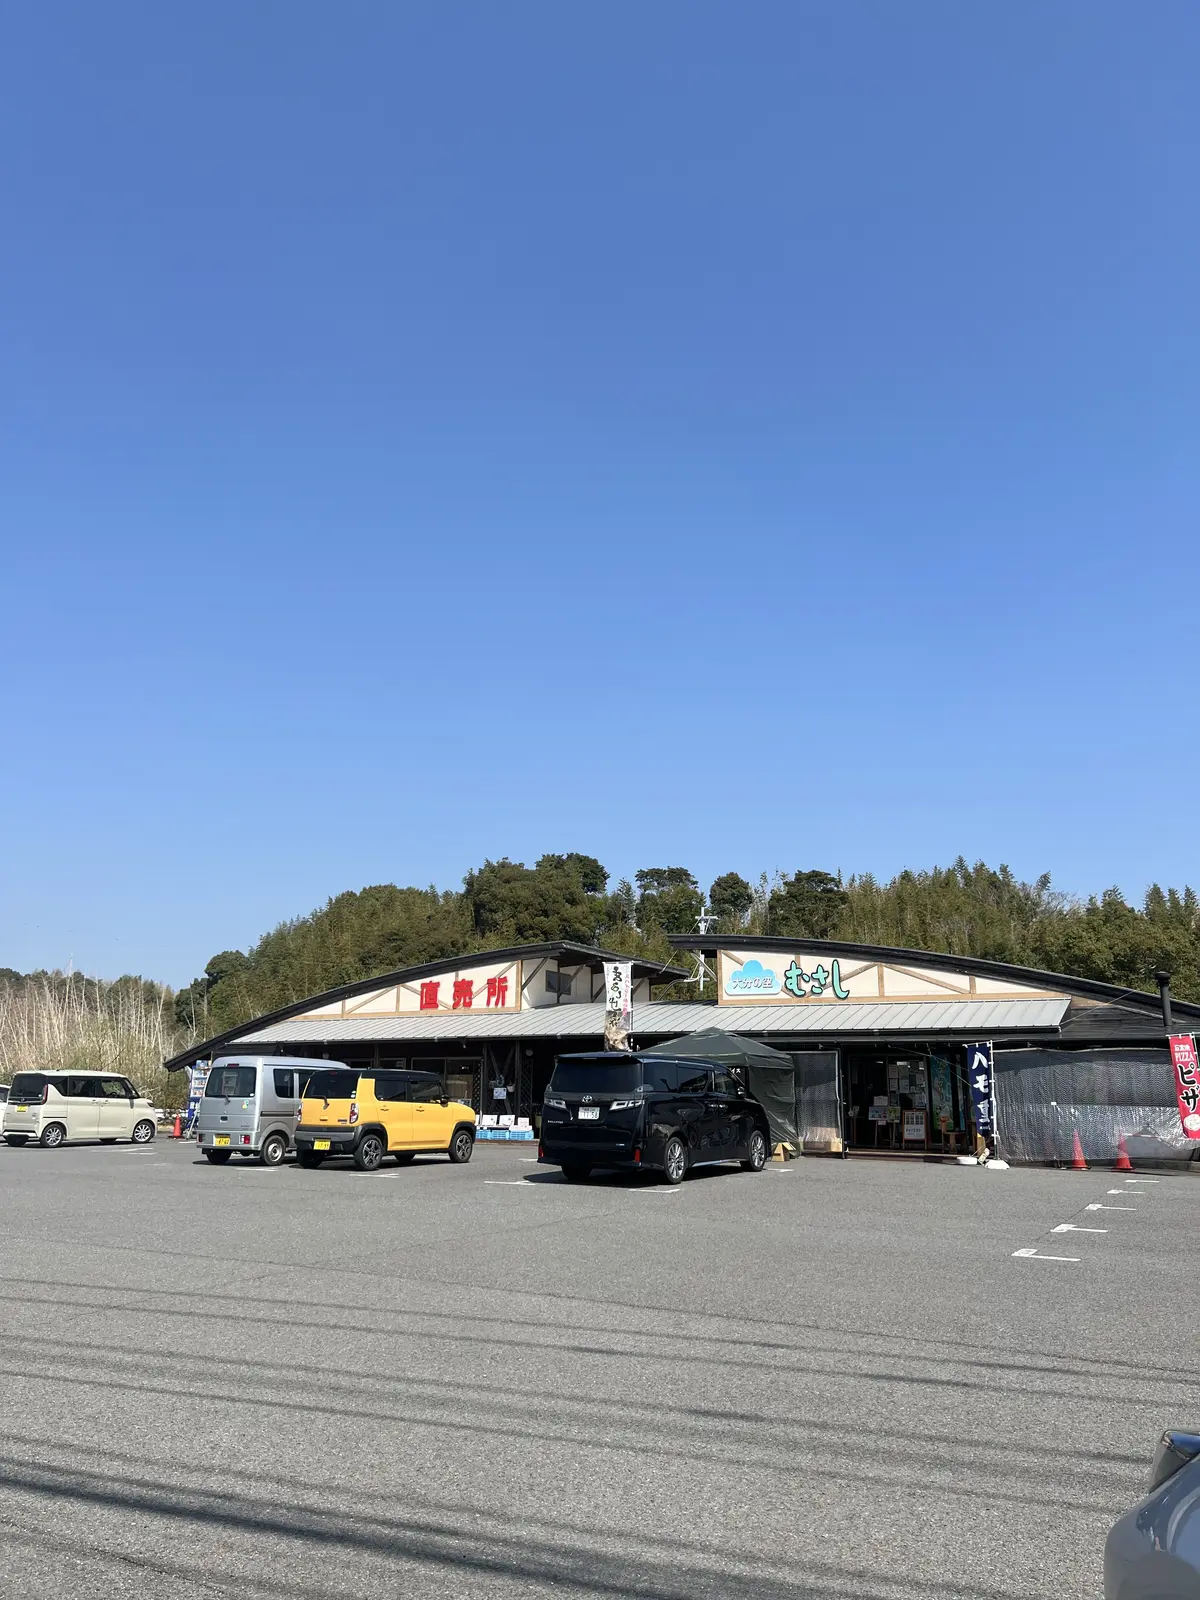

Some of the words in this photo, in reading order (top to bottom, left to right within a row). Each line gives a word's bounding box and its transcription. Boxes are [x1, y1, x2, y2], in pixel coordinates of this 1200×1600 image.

[420, 976, 508, 1010] 直売所
[733, 977, 773, 989] 大分の空
[784, 959, 850, 1000] むさし
[1174, 1052, 1195, 1062] PIZZA
[1177, 1062, 1200, 1113] ピザ
